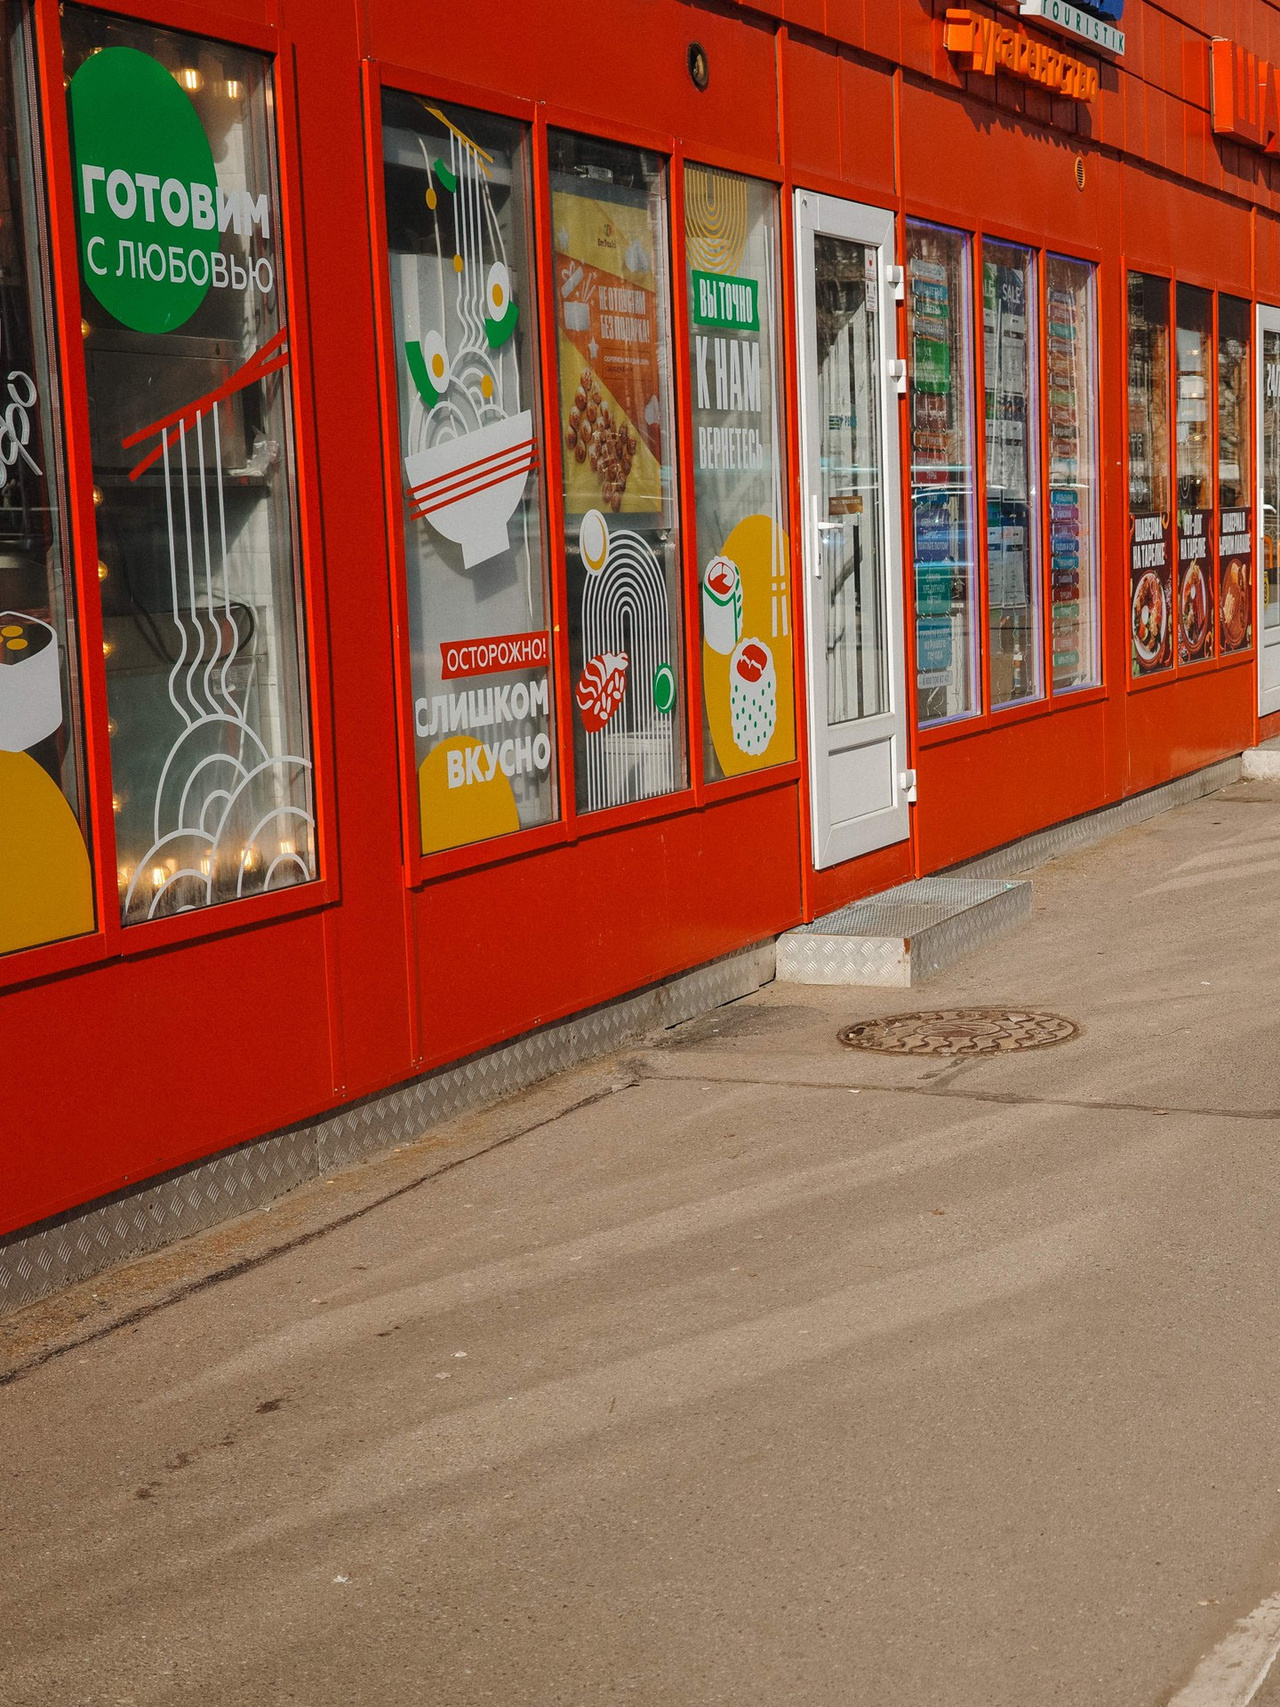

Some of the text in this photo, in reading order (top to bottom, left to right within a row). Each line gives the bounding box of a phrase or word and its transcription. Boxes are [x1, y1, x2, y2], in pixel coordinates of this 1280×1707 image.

[81, 163, 271, 239] ГОТОВИМ
[87, 236, 274, 294] С ЛЮБОВЬЮ
[1002, 283, 1022, 304] SALE
[699, 278, 753, 324] ВЫ ТОЧНО
[695, 336, 762, 412] К НАМ
[699, 426, 763, 470] ВЕРНЕТЕСЬ
[446, 637, 547, 673] ОСТОРОЖНО!
[415, 679, 549, 738] СЛИШКОМ
[446, 732, 551, 789] ВКУСНО
